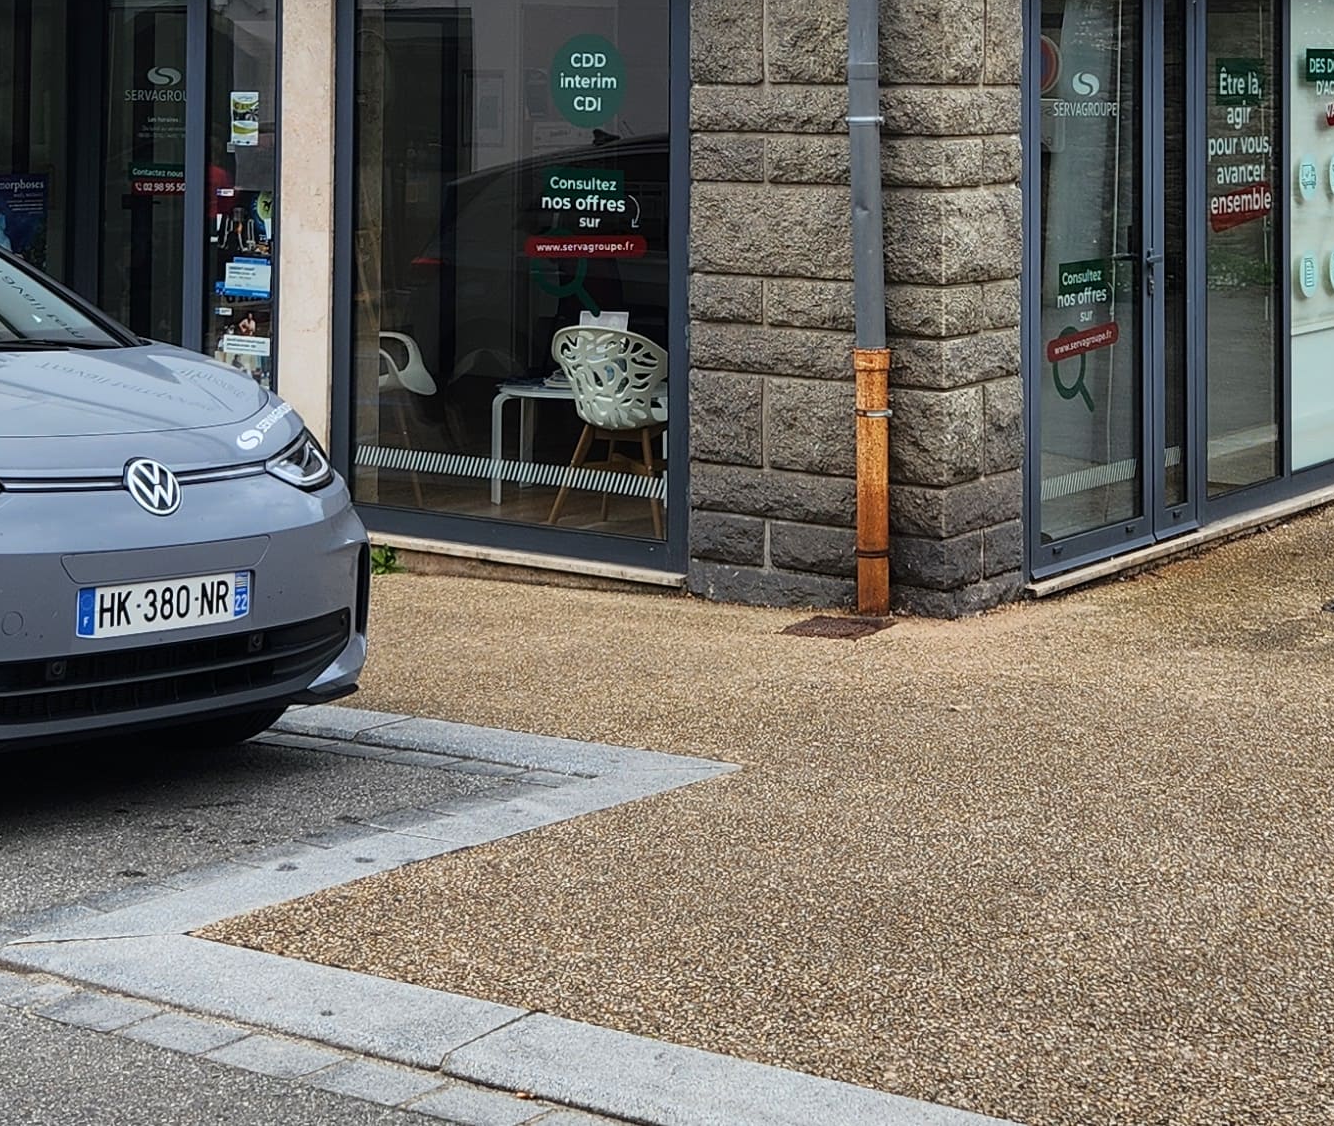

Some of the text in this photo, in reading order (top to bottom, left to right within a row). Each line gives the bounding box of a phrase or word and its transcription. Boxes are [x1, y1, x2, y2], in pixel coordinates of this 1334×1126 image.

[570, 53, 607, 68] CDD
[1309, 58, 1326, 73] DES
[560, 73, 617, 89] interim
[1219, 67, 1262, 99] Être là,
[573, 96, 602, 111] CDI
[1053, 101, 1118, 117] SERVAGROUPE
[1226, 100, 1252, 129] agir
[1208, 135, 1273, 161] pour vous,
[1217, 164, 1266, 184] avancer
[549, 176, 617, 191] Consultez
[541, 194, 626, 213] nos offres
[1210, 186, 1272, 215] ensemble
[579, 216, 601, 228] sur
[535, 241, 635, 253] www.servagroupe.fr
[1061, 269, 1103, 286] Consultez
[1056, 286, 1108, 309] nos offres
[1079, 310, 1094, 323] sur
[234, 593, 248, 612] 22
